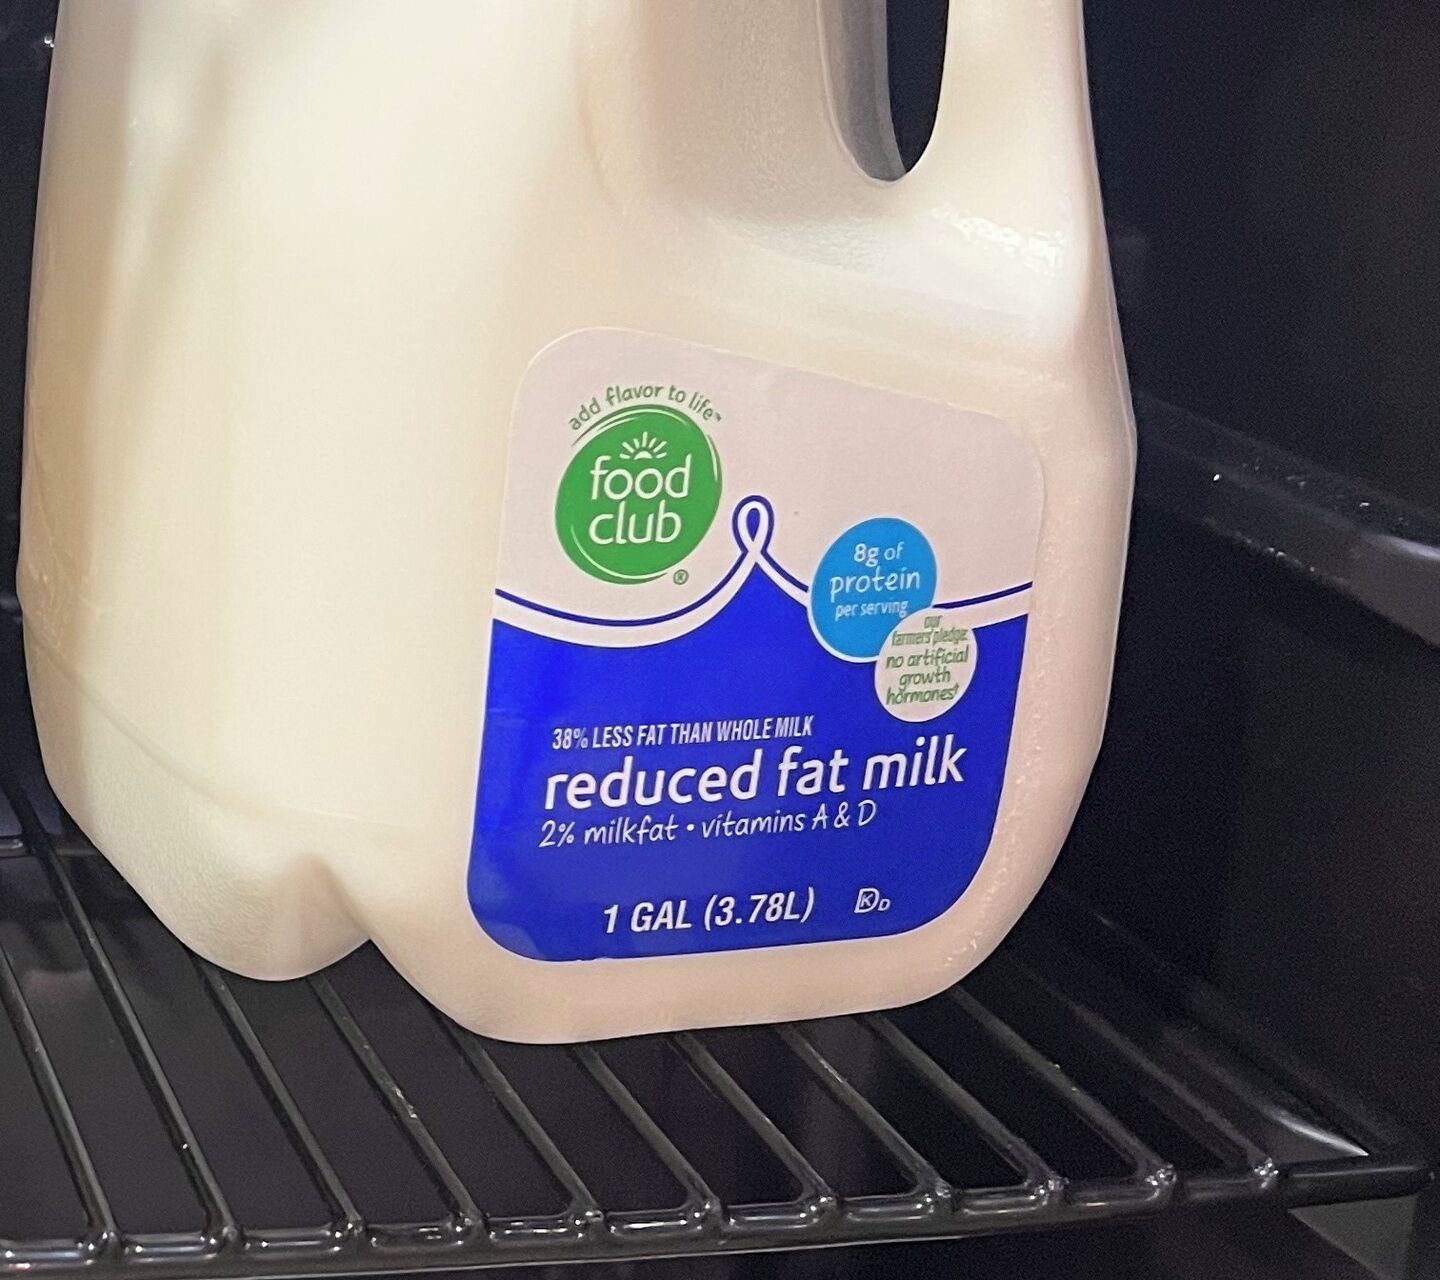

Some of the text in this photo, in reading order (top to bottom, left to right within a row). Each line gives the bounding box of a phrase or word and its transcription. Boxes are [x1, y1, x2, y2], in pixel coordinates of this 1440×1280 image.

[569, 385, 686, 430] add flavor to
[590, 454, 691, 500] food
[589, 499, 681, 545] club
[854, 542, 904, 567] 8g of
[830, 567, 920, 603] protein
[835, 598, 908, 622] per serving
[886, 646, 969, 669] no artificial
[899, 667, 950, 691] growth
[552, 715, 814, 750] 38% LESS FAT THAN WHOLE MILK
[544, 734, 967, 810] reduced fat milk
[539, 799, 876, 847] 2% milkfat vitamins A & D
[603, 887, 814, 933] 1 GAL (3.78L)
